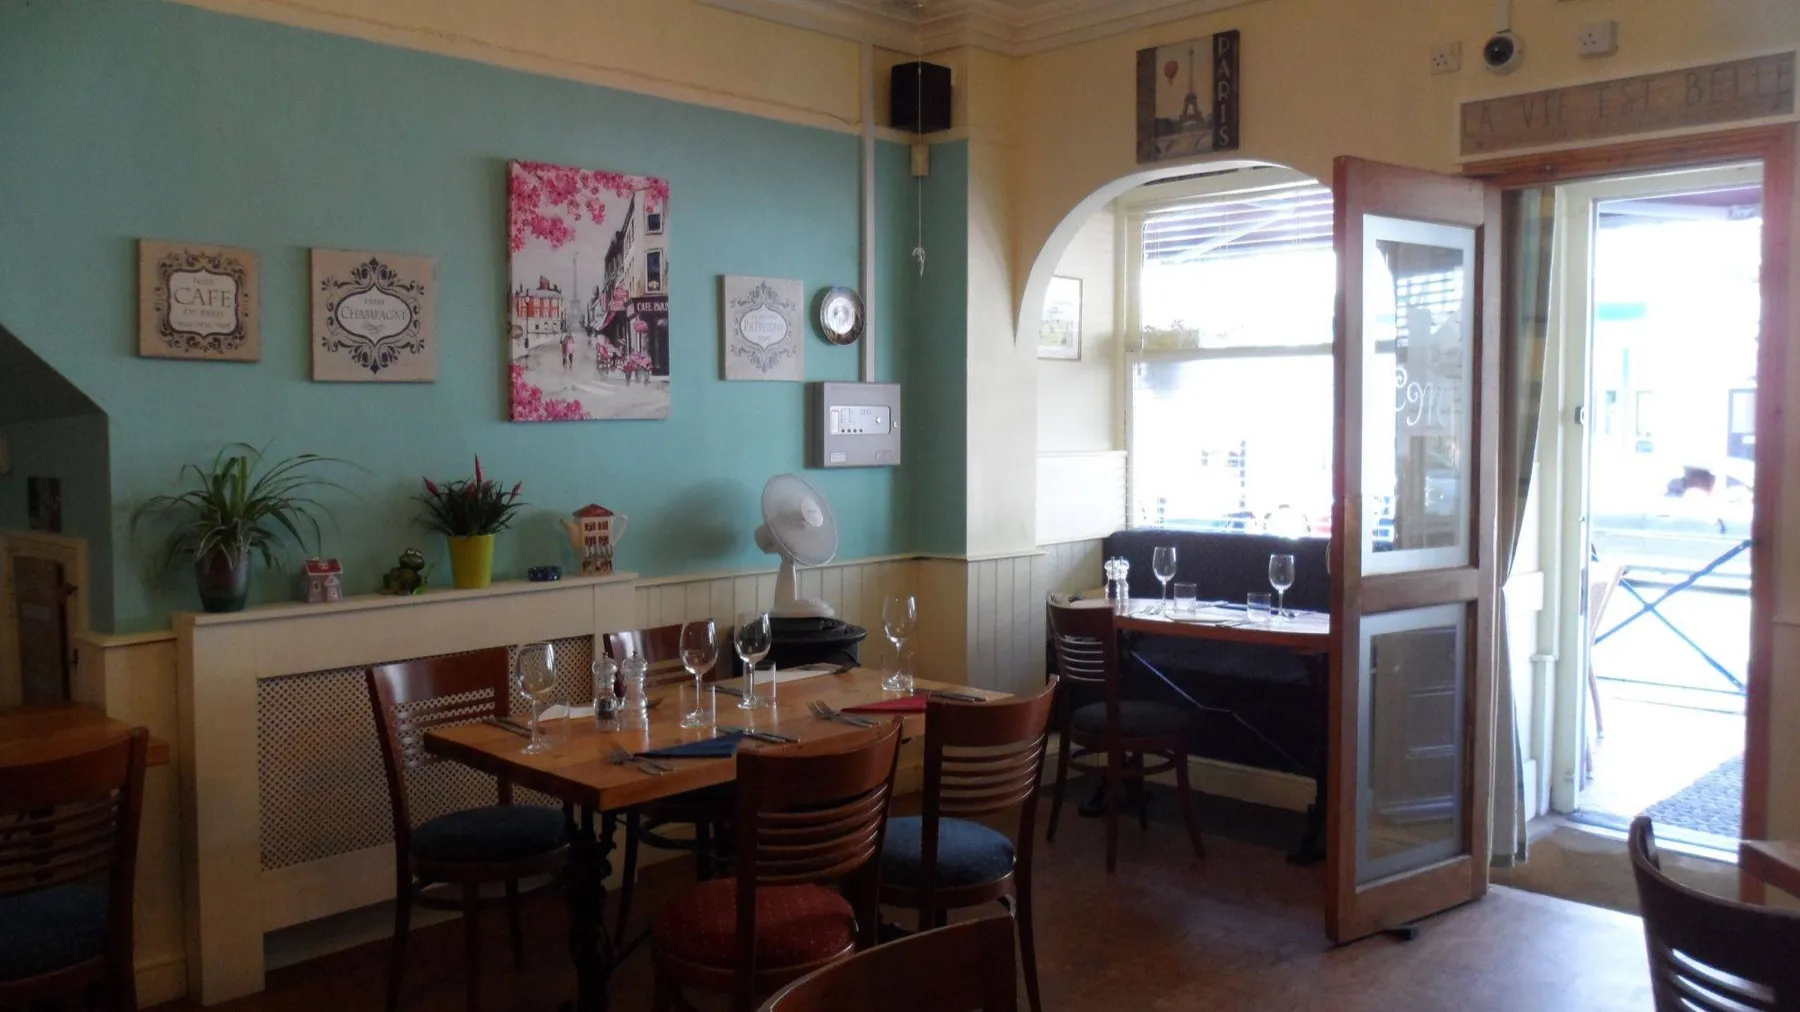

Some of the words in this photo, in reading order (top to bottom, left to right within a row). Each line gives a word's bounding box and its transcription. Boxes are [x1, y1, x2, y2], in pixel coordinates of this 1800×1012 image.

[1217, 36, 1231, 147] PARIS
[1462, 100, 1496, 138] LA
[1520, 93, 1571, 128] VIE
[1597, 79, 1651, 120] EST
[1684, 62, 1793, 108] BELLE
[174, 288, 233, 308] CAFE
[637, 302, 652, 312] CAFE
